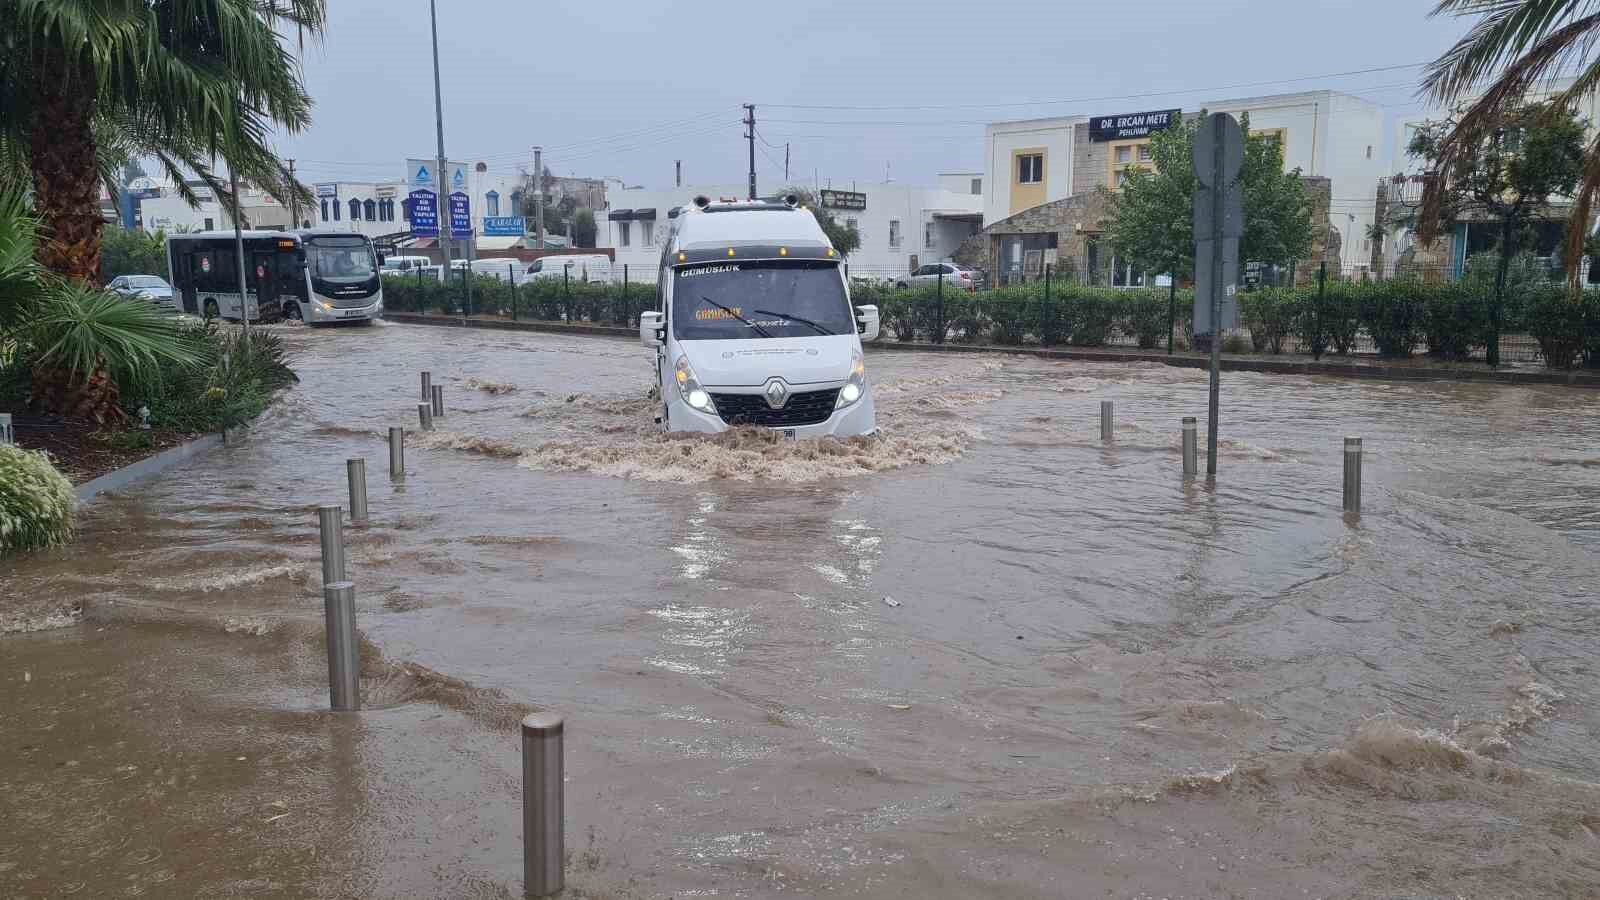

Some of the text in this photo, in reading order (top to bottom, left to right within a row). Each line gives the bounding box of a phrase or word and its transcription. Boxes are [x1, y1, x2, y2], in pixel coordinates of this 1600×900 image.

[1101, 113, 1169, 129] DR. ERCAN METE
